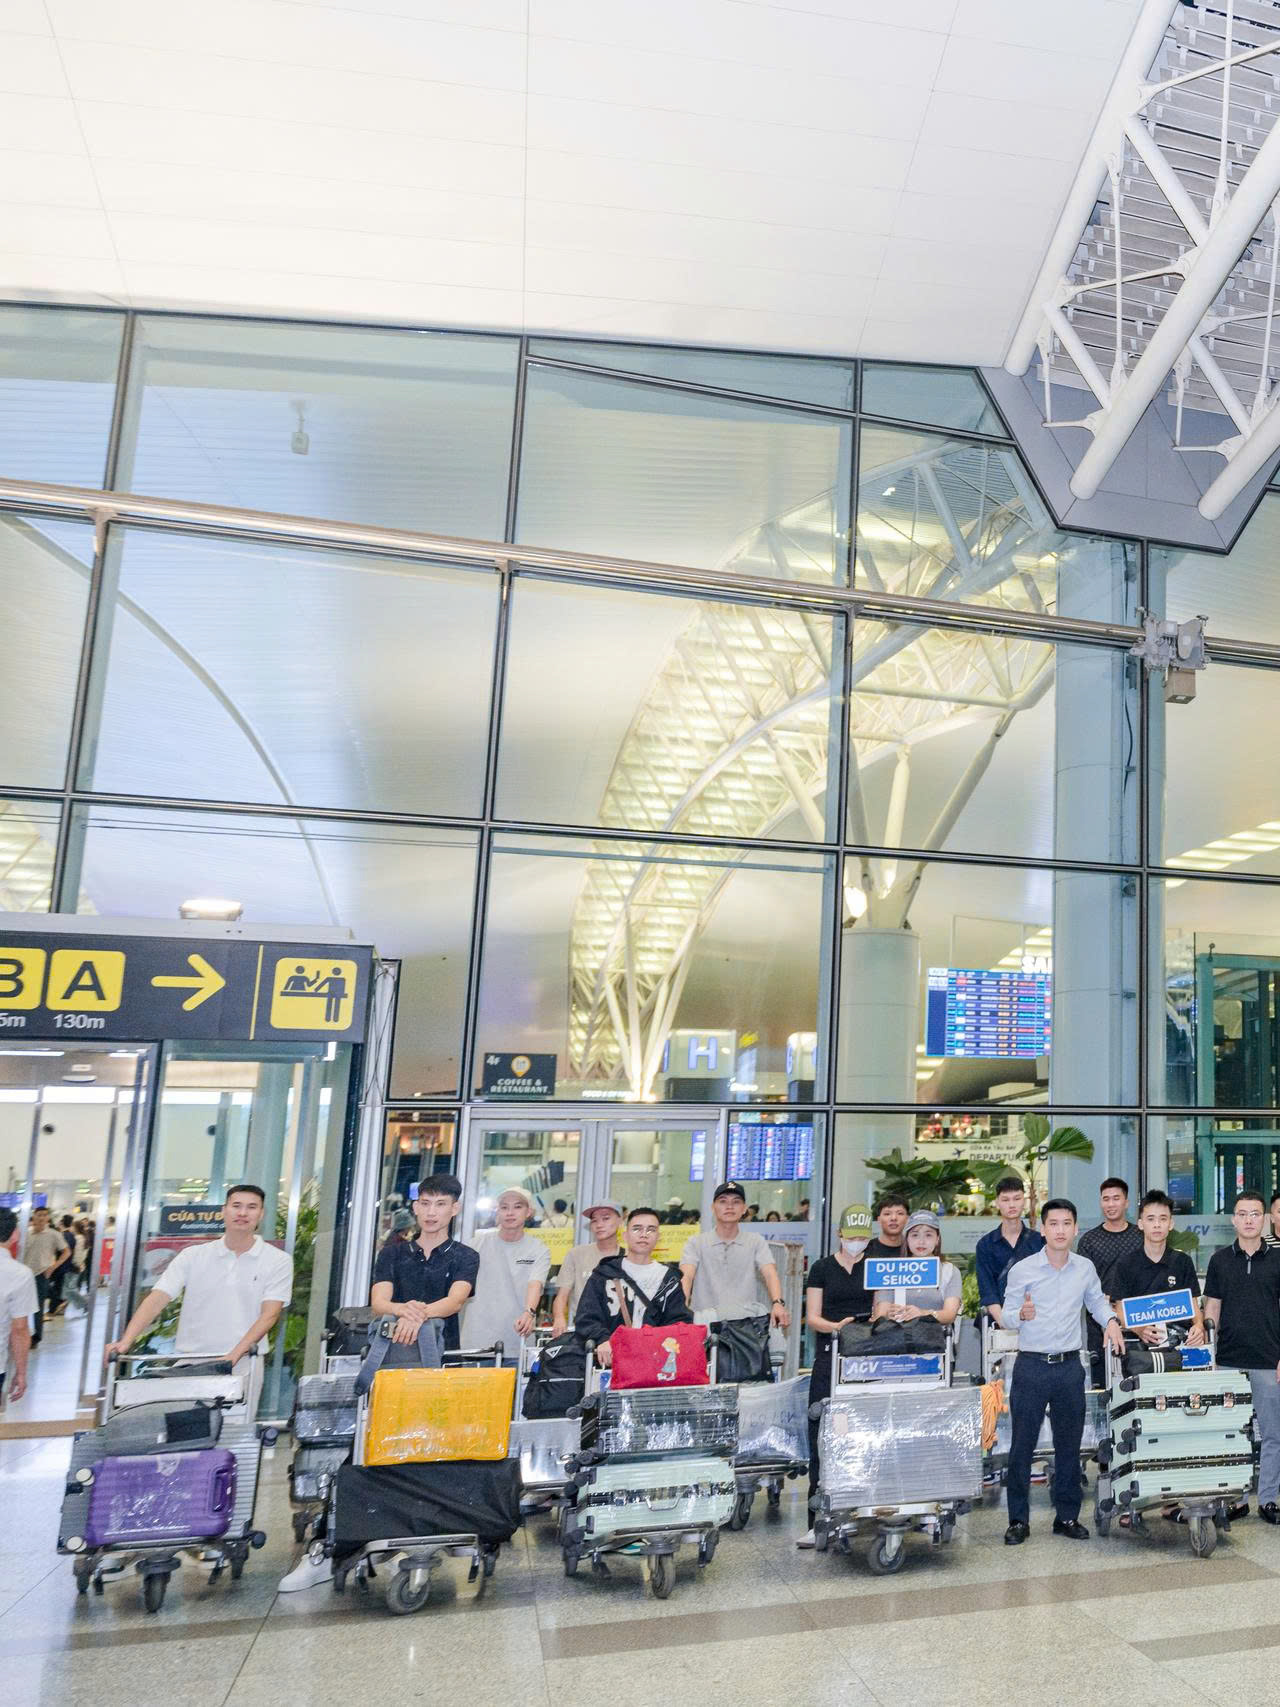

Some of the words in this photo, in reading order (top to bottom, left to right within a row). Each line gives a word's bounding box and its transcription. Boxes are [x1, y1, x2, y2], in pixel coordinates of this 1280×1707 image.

[60, 960, 106, 1001] A
[53, 1013, 105, 1030] 130m
[688, 1037, 717, 1069] H
[846, 1213, 871, 1228] ICON
[876, 1263, 896, 1273] DU
[898, 1262, 929, 1275] HỌC
[882, 1275, 922, 1285] SEIKO
[1129, 1311, 1156, 1323] TEAM
[1157, 1304, 1188, 1318] KOREA
[846, 1361, 879, 1375] ACV
